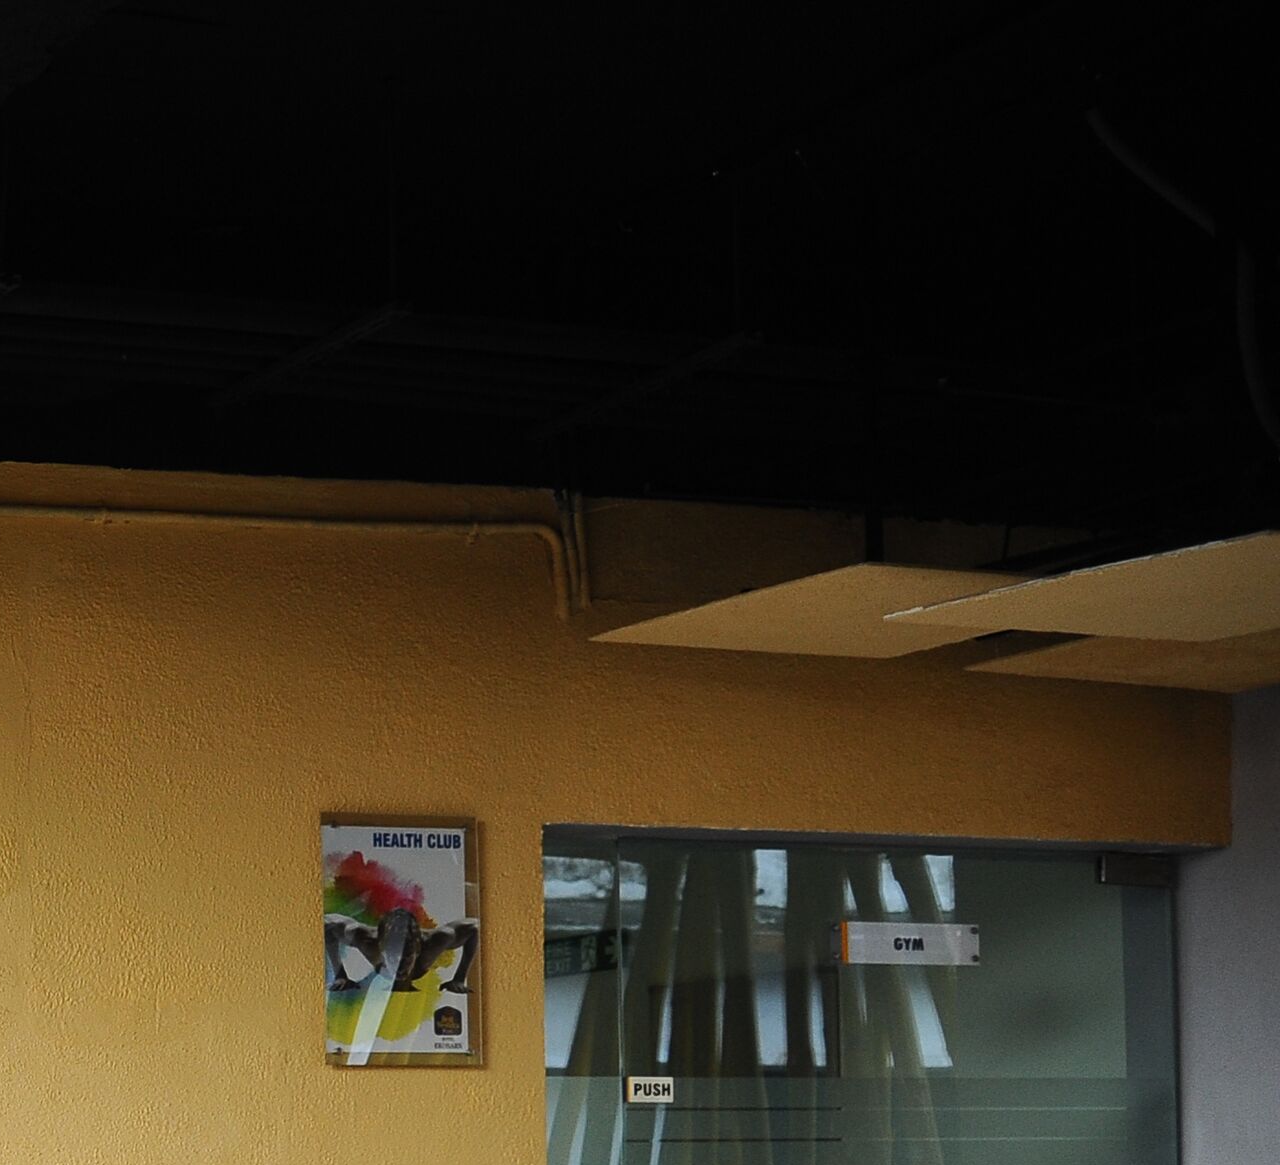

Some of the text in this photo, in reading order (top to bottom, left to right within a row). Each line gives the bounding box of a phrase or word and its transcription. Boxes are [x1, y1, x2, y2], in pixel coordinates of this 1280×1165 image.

[373, 833, 461, 849] HEALTH CLUB
[893, 937, 925, 951] GYM
[633, 1083, 671, 1097] PUSH
